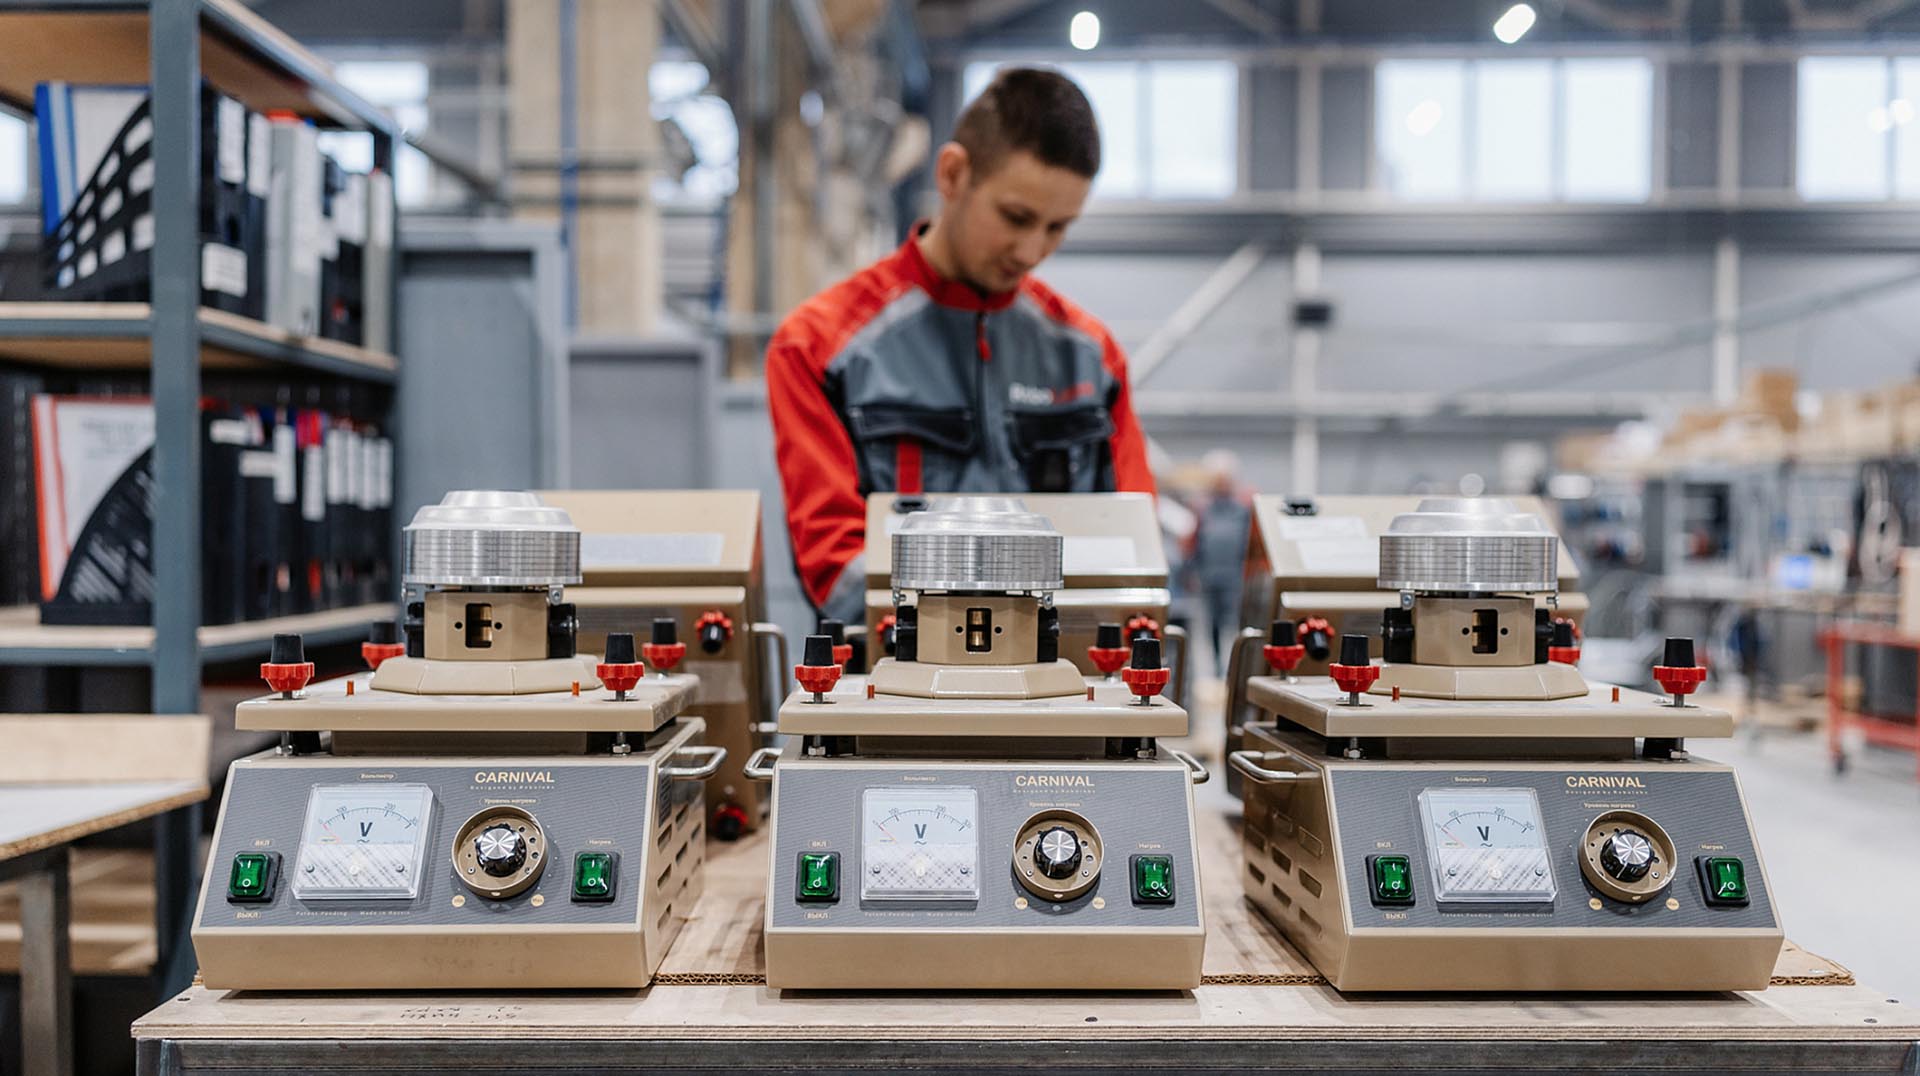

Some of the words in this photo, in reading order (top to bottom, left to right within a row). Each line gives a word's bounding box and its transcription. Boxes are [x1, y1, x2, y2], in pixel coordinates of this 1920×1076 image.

[475, 771, 555, 783] CARNIVAL
[1015, 775, 1095, 787] CARNIVAL
[1566, 776, 1646, 788] CARNIVAL
[360, 822, 373, 837] V
[914, 824, 927, 839] V
[1477, 826, 1490, 841] V
